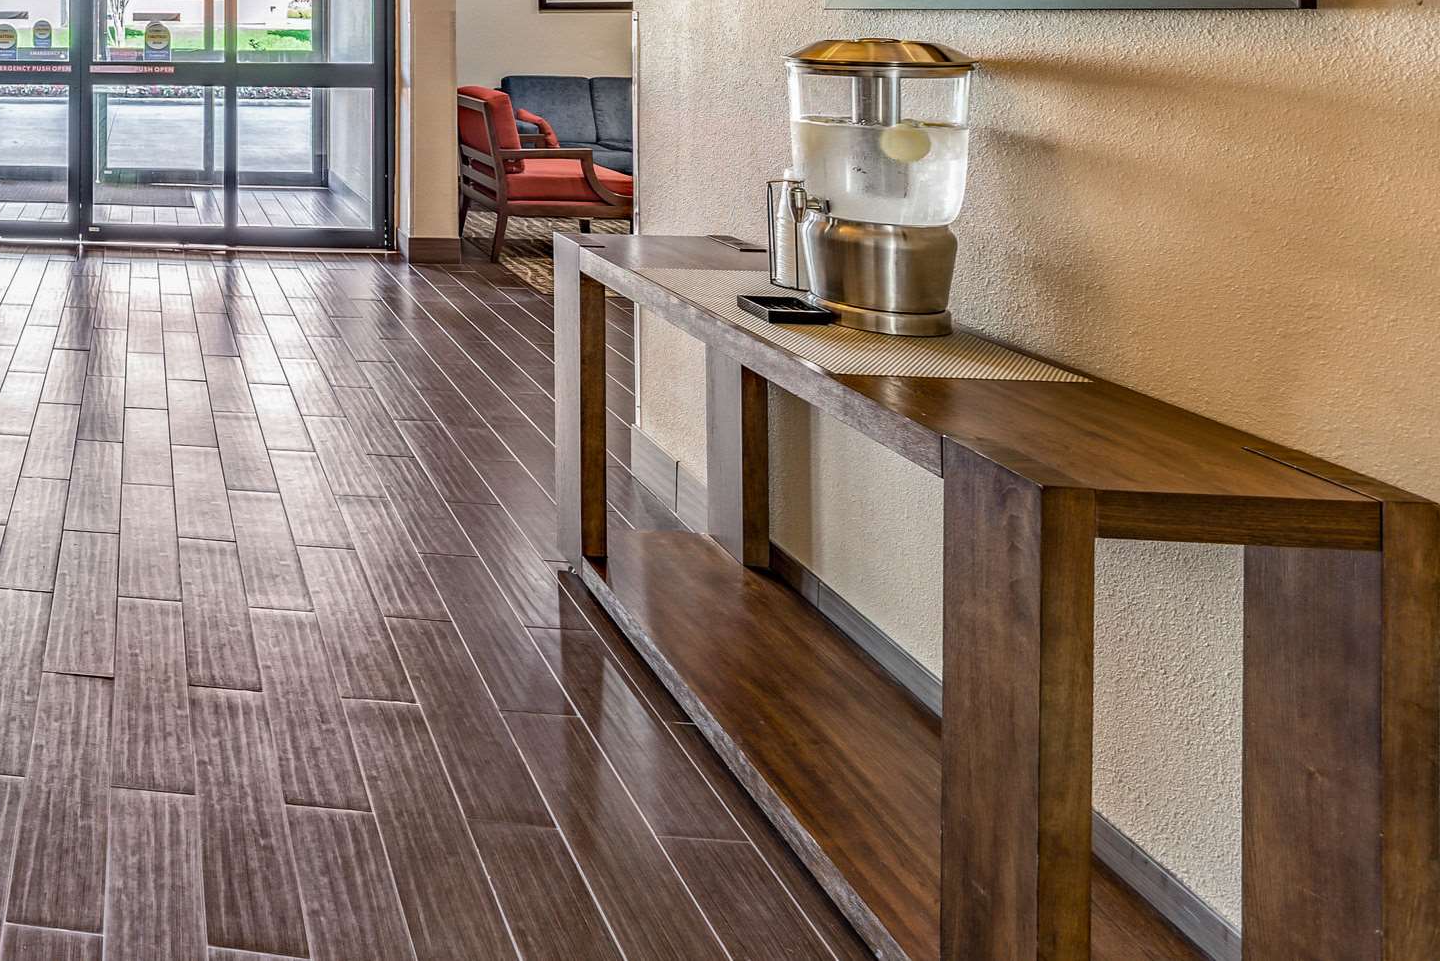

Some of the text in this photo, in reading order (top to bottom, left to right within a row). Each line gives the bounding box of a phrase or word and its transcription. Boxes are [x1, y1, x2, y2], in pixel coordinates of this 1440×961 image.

[32, 64, 52, 72] PUSH
[51, 64, 72, 73] OPEN
[154, 65, 175, 73] OPEN
